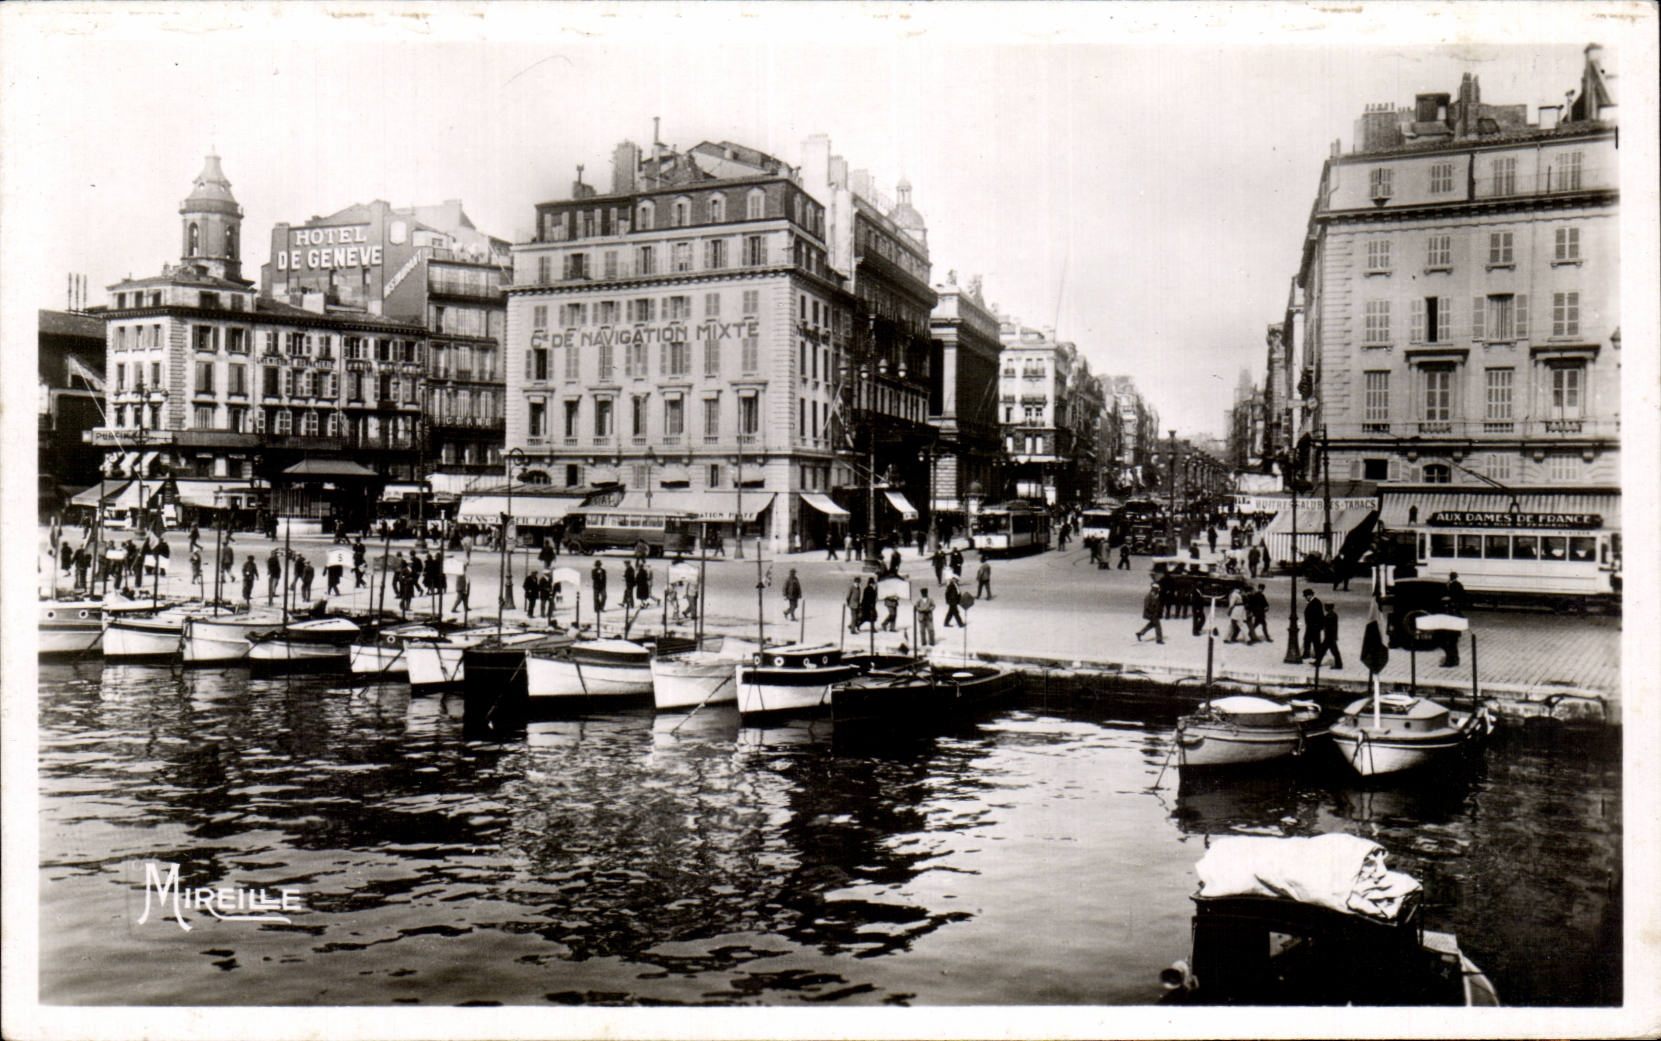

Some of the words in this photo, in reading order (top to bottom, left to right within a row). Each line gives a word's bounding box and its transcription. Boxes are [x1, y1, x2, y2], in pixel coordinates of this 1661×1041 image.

[295, 227, 367, 246] HOTEL
[277, 250, 301, 270] DE
[552, 333, 574, 348] DE
[581, 327, 688, 346] NAVIGATION
[696, 322, 760, 340] MIXTE
[1436, 512, 1462, 521] AUX
[1465, 513, 1512, 522] DAMES
[1516, 514, 1534, 523] DE
[1538, 514, 1591, 524] FRANCE
